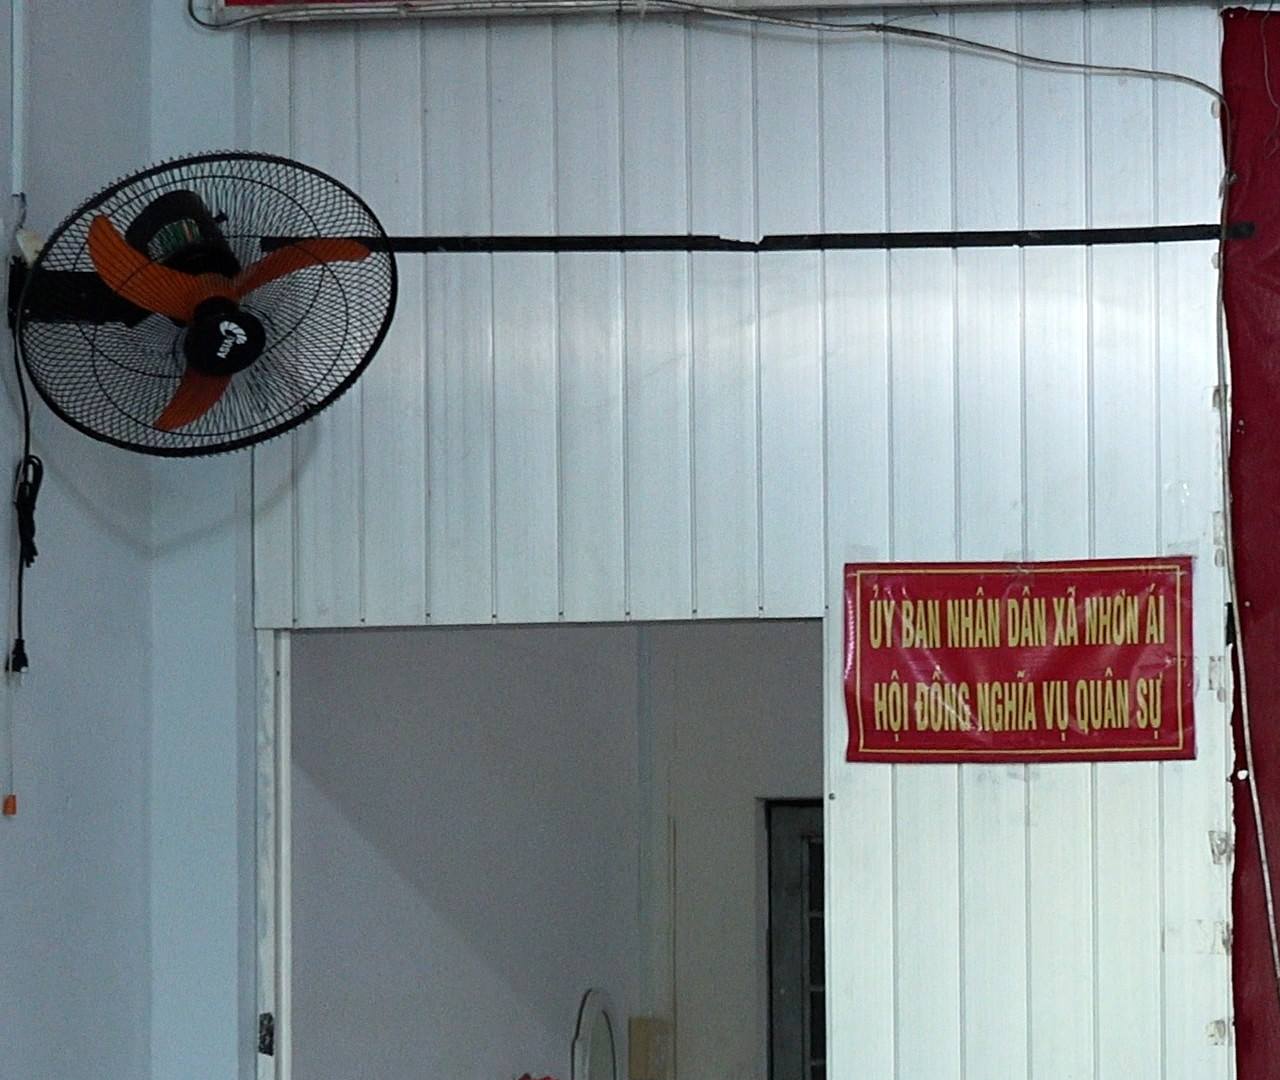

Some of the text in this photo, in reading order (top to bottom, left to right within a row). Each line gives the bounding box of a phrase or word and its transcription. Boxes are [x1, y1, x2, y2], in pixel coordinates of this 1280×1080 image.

[869, 583, 1165, 649] ỦY BAN NHÂN DÂN XÃ NHƠN ÁI
[874, 669, 909, 742] HỘI
[977, 670, 1037, 732] NGHĨA
[1043, 680, 1070, 741] VỤ
[1075, 667, 1130, 735] QUÂN
[1136, 672, 1164, 739] SỰ
